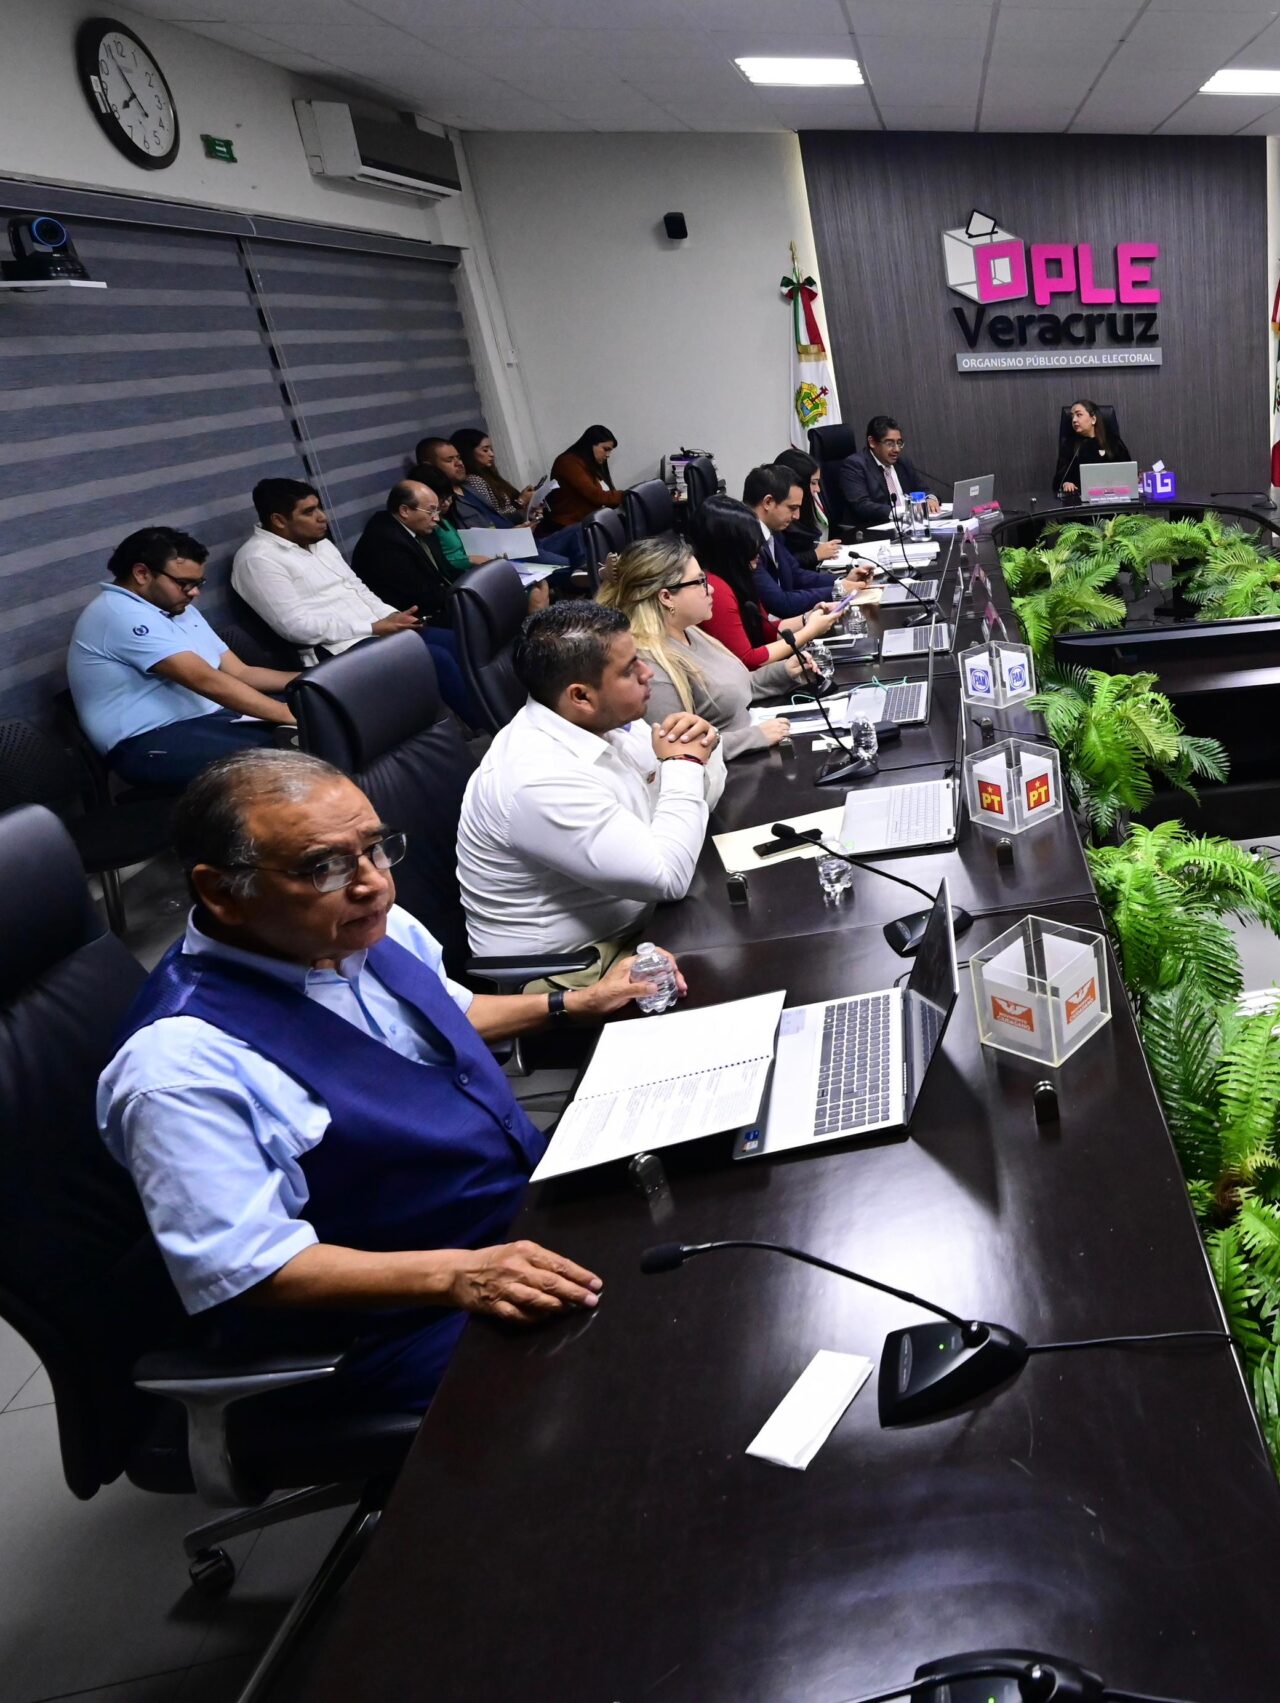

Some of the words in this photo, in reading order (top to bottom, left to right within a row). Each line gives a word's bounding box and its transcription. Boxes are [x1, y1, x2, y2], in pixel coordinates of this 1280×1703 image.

[154, 94, 163, 111] 3
[143, 134, 150, 150] 6
[153, 130, 161, 146] 5
[974, 239, 1161, 306] OPLE
[953, 307, 1159, 348] Veracruz
[962, 356, 1024, 368] ORGANISMO
[1025, 354, 1067, 367] PÚBLICO
[1069, 355, 1101, 365] LOCAL
[1102, 353, 1155, 364] ELECTORAL
[982, 792, 1001, 811] PT
[1029, 785, 1048, 808] PT
